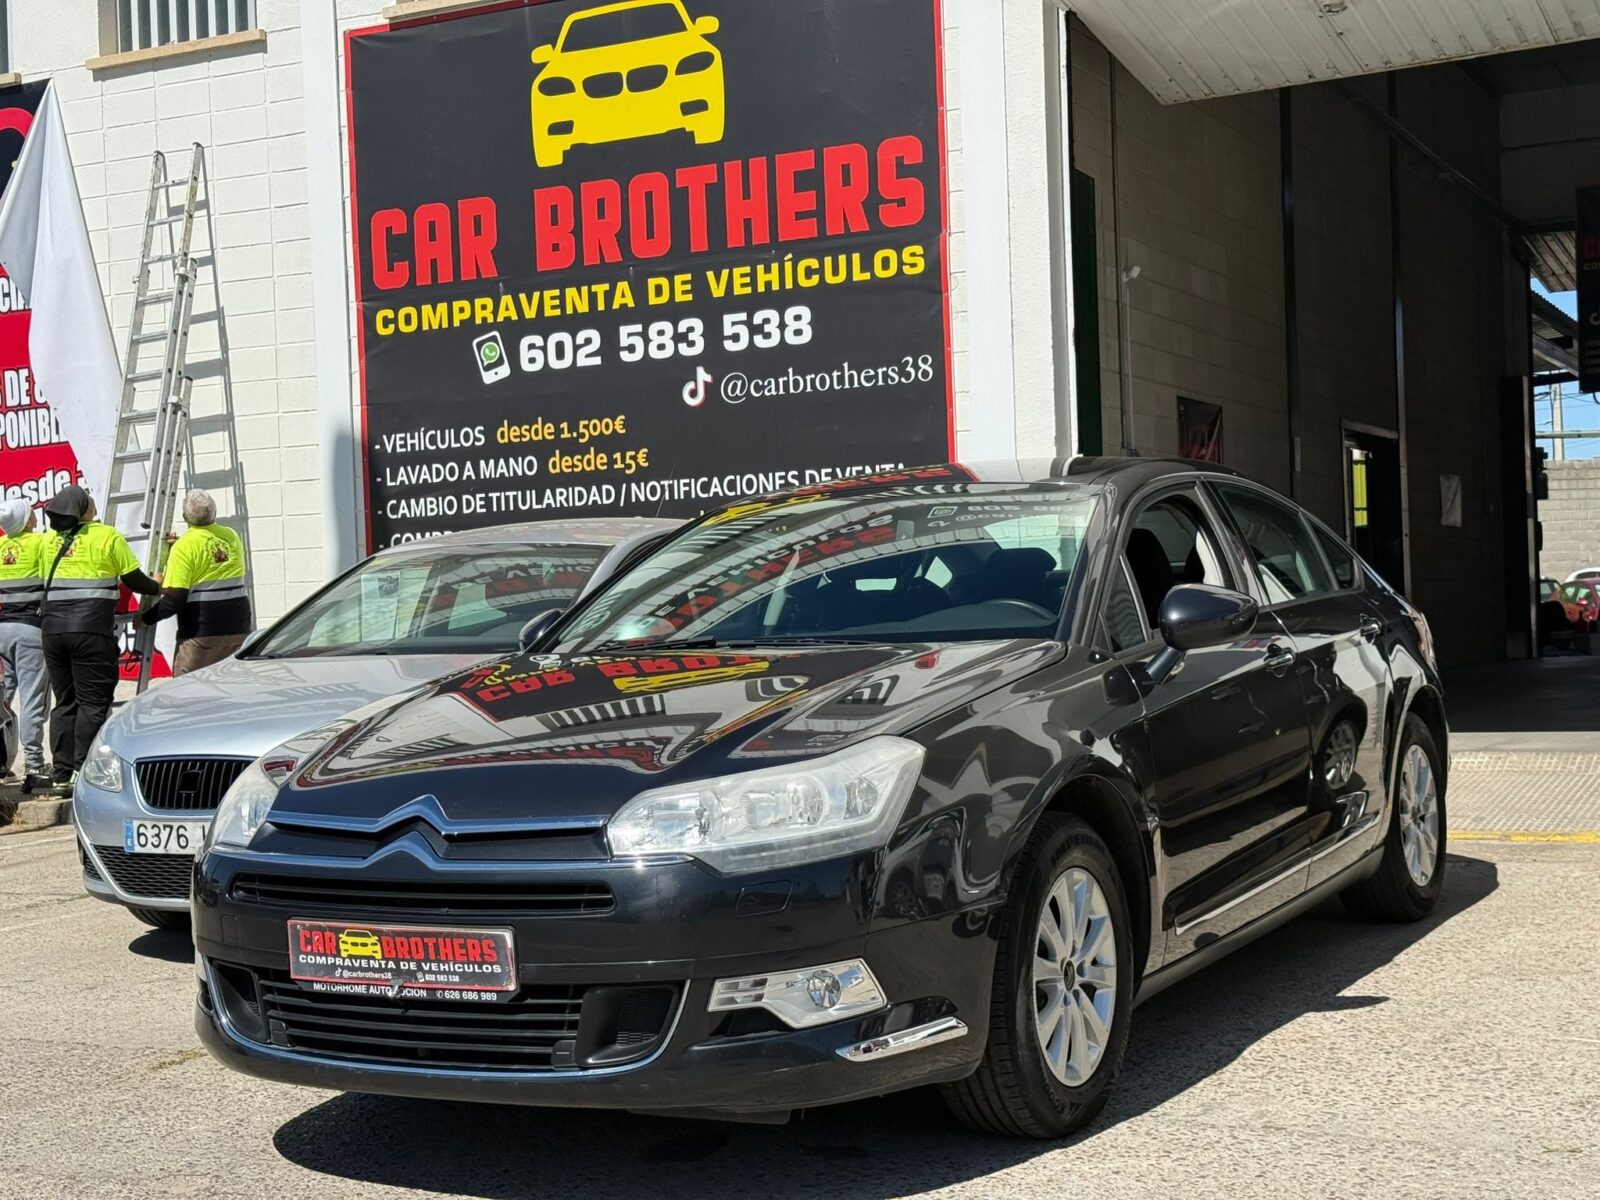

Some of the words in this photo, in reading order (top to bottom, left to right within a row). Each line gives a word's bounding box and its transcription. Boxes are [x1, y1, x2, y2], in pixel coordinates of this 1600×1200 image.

[370, 195, 500, 290] CAR
[533, 134, 926, 273] BROTHERS
[375, 281, 636, 336] COMPRAVENTA
[648, 273, 693, 306] DE
[706, 244, 926, 299] VEHÍCULOS
[519, 328, 602, 372] 602
[619, 317, 705, 363] 583
[722, 305, 813, 352] 538
[4, 368, 31, 407] DE
[720, 354, 934, 404] @carbrothers38
[383, 425, 486, 454] VEHÍCULOS
[496, 416, 555, 444] desde
[559, 414, 627, 443] 1.500€
[386, 461, 460, 487] LAVADO
[462, 460, 476, 481] A
[479, 455, 538, 479] MANO
[548, 446, 608, 475] desde
[612, 448, 650, 475] 15€
[386, 496, 458, 520] CAMBIO
[462, 492, 486, 514] DE
[489, 484, 616, 513] TITULARIDAD
[631, 470, 800, 502] NOTIFICACIONES
[804, 467, 833, 485] DE
[136, 823, 189, 850] 6376
[298, 954, 396, 970] COMPRAVENTA
[400, 961, 418, 971] DE
[421, 960, 502, 974] VEHÍCULOS
[300, 930, 337, 954] CAR
[381, 936, 497, 962] BROTHERS
[313, 981, 368, 995] MOTORHOME
[444, 990, 461, 1000] 626
[462, 991, 479, 1001] 686
[480, 992, 498, 1002] 989
[342, 969, 393, 980] @carbrothers38
